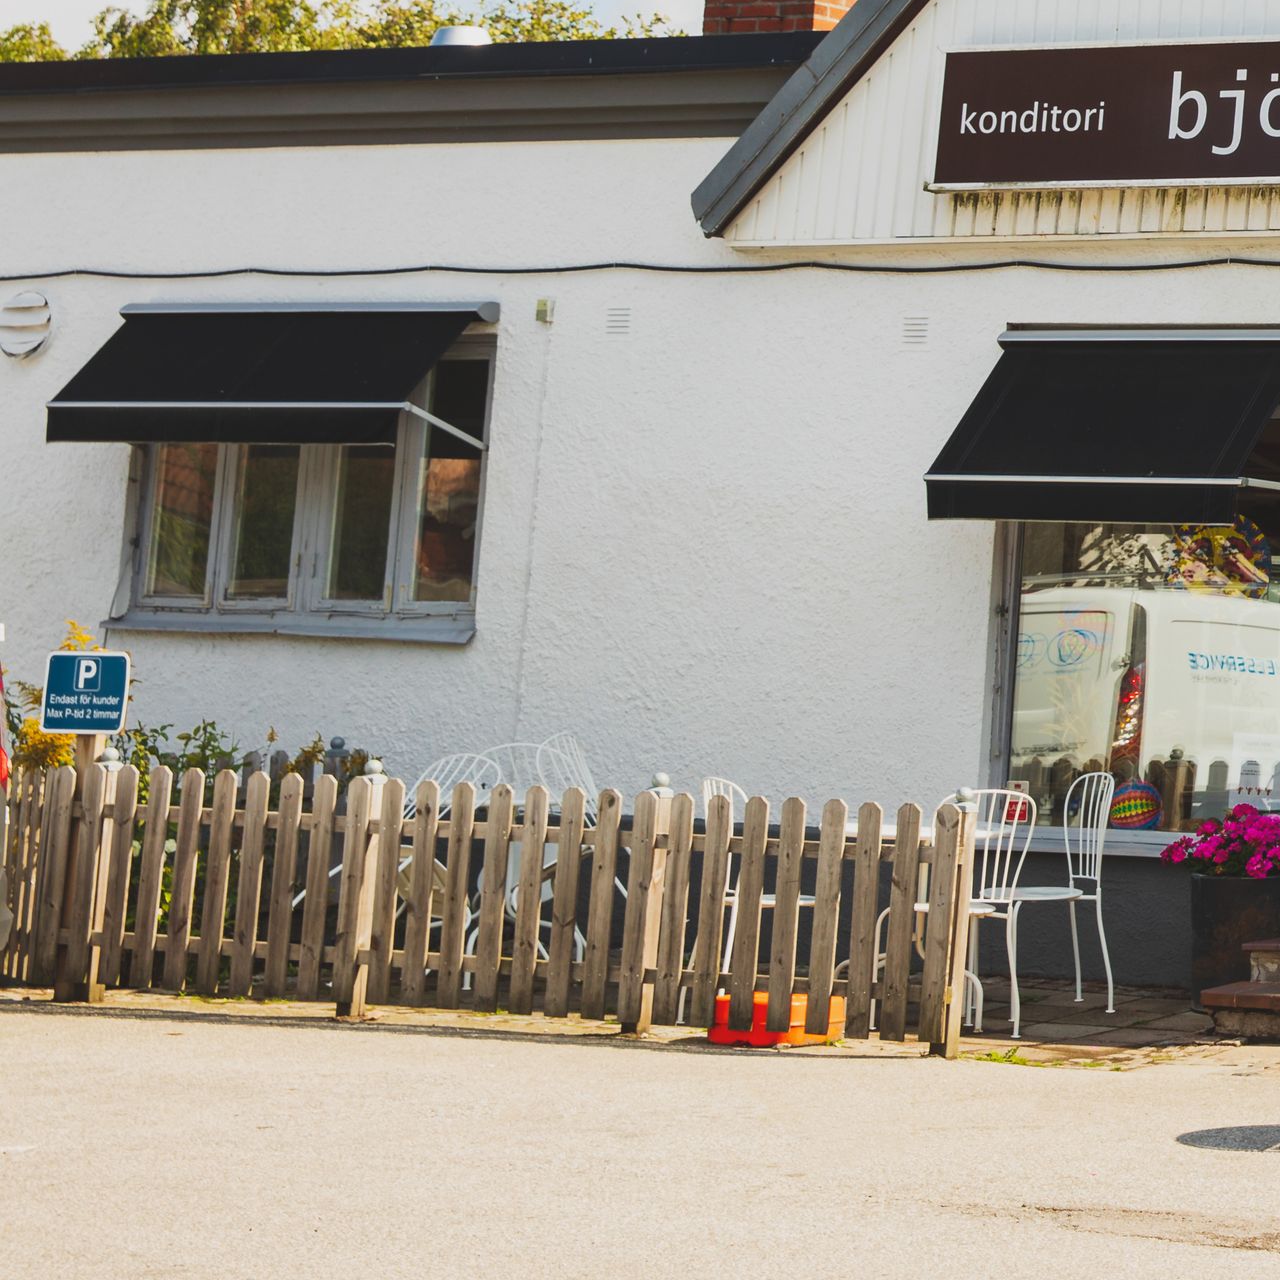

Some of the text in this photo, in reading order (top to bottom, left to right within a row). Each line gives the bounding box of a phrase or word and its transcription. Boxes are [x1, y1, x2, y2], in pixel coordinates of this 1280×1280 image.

[961, 102, 1105, 134] konditori
[78, 659, 98, 689] P
[49, 693, 120, 706] Endast för kunder
[46, 707, 120, 719] Max P-tid 2 timmar
